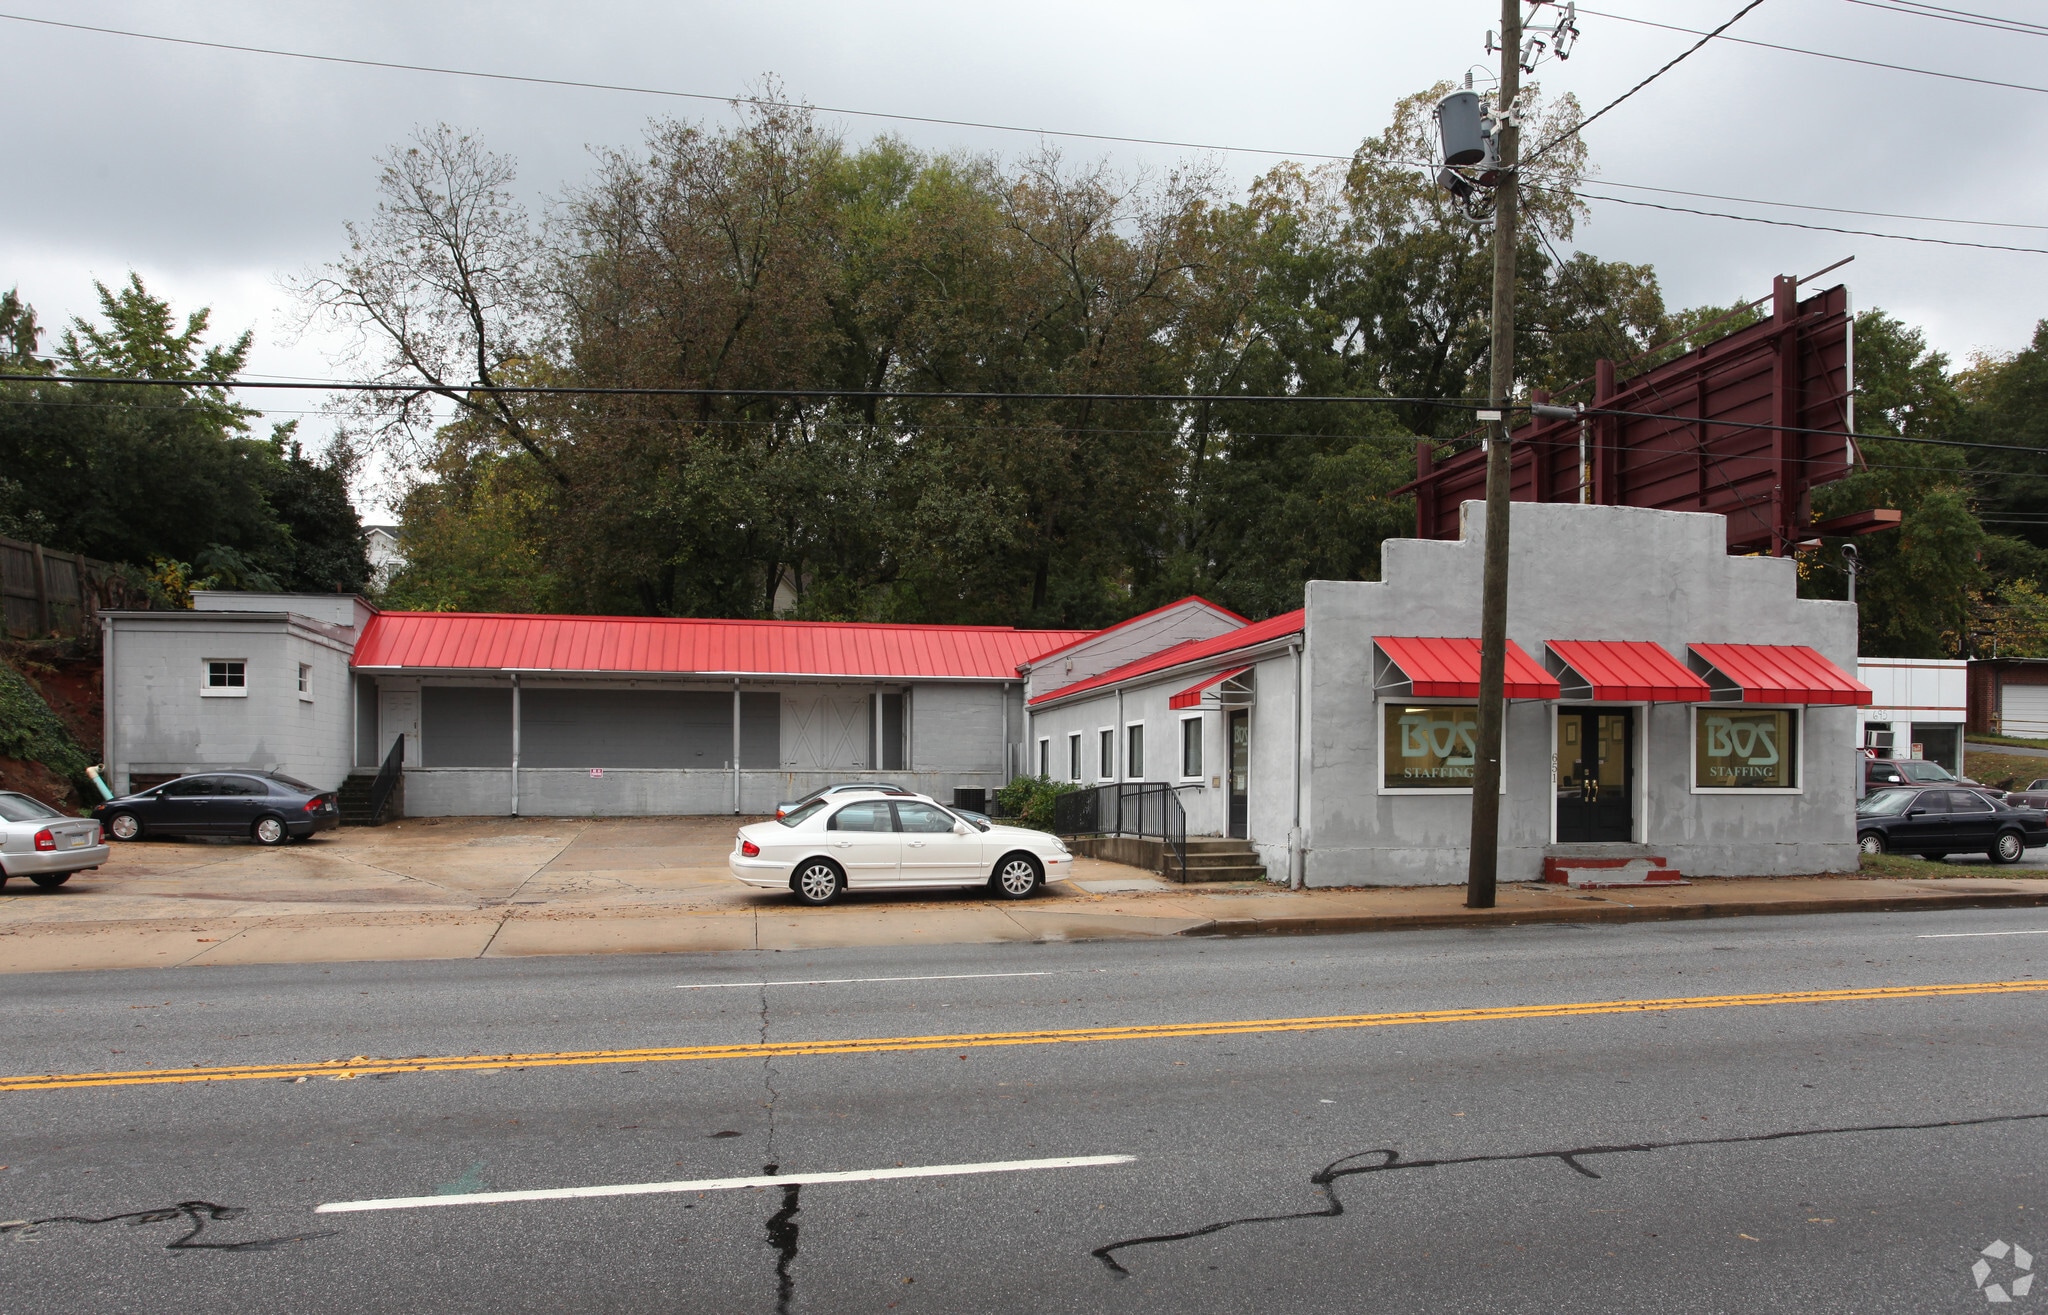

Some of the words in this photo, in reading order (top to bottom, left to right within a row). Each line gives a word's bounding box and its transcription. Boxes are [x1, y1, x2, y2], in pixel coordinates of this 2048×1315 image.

[1872, 709, 1888, 721] 695
[1705, 717, 1779, 766] BOS
[1404, 767, 1475, 779] STAFFING
[1709, 766, 1774, 778] STAFFING
